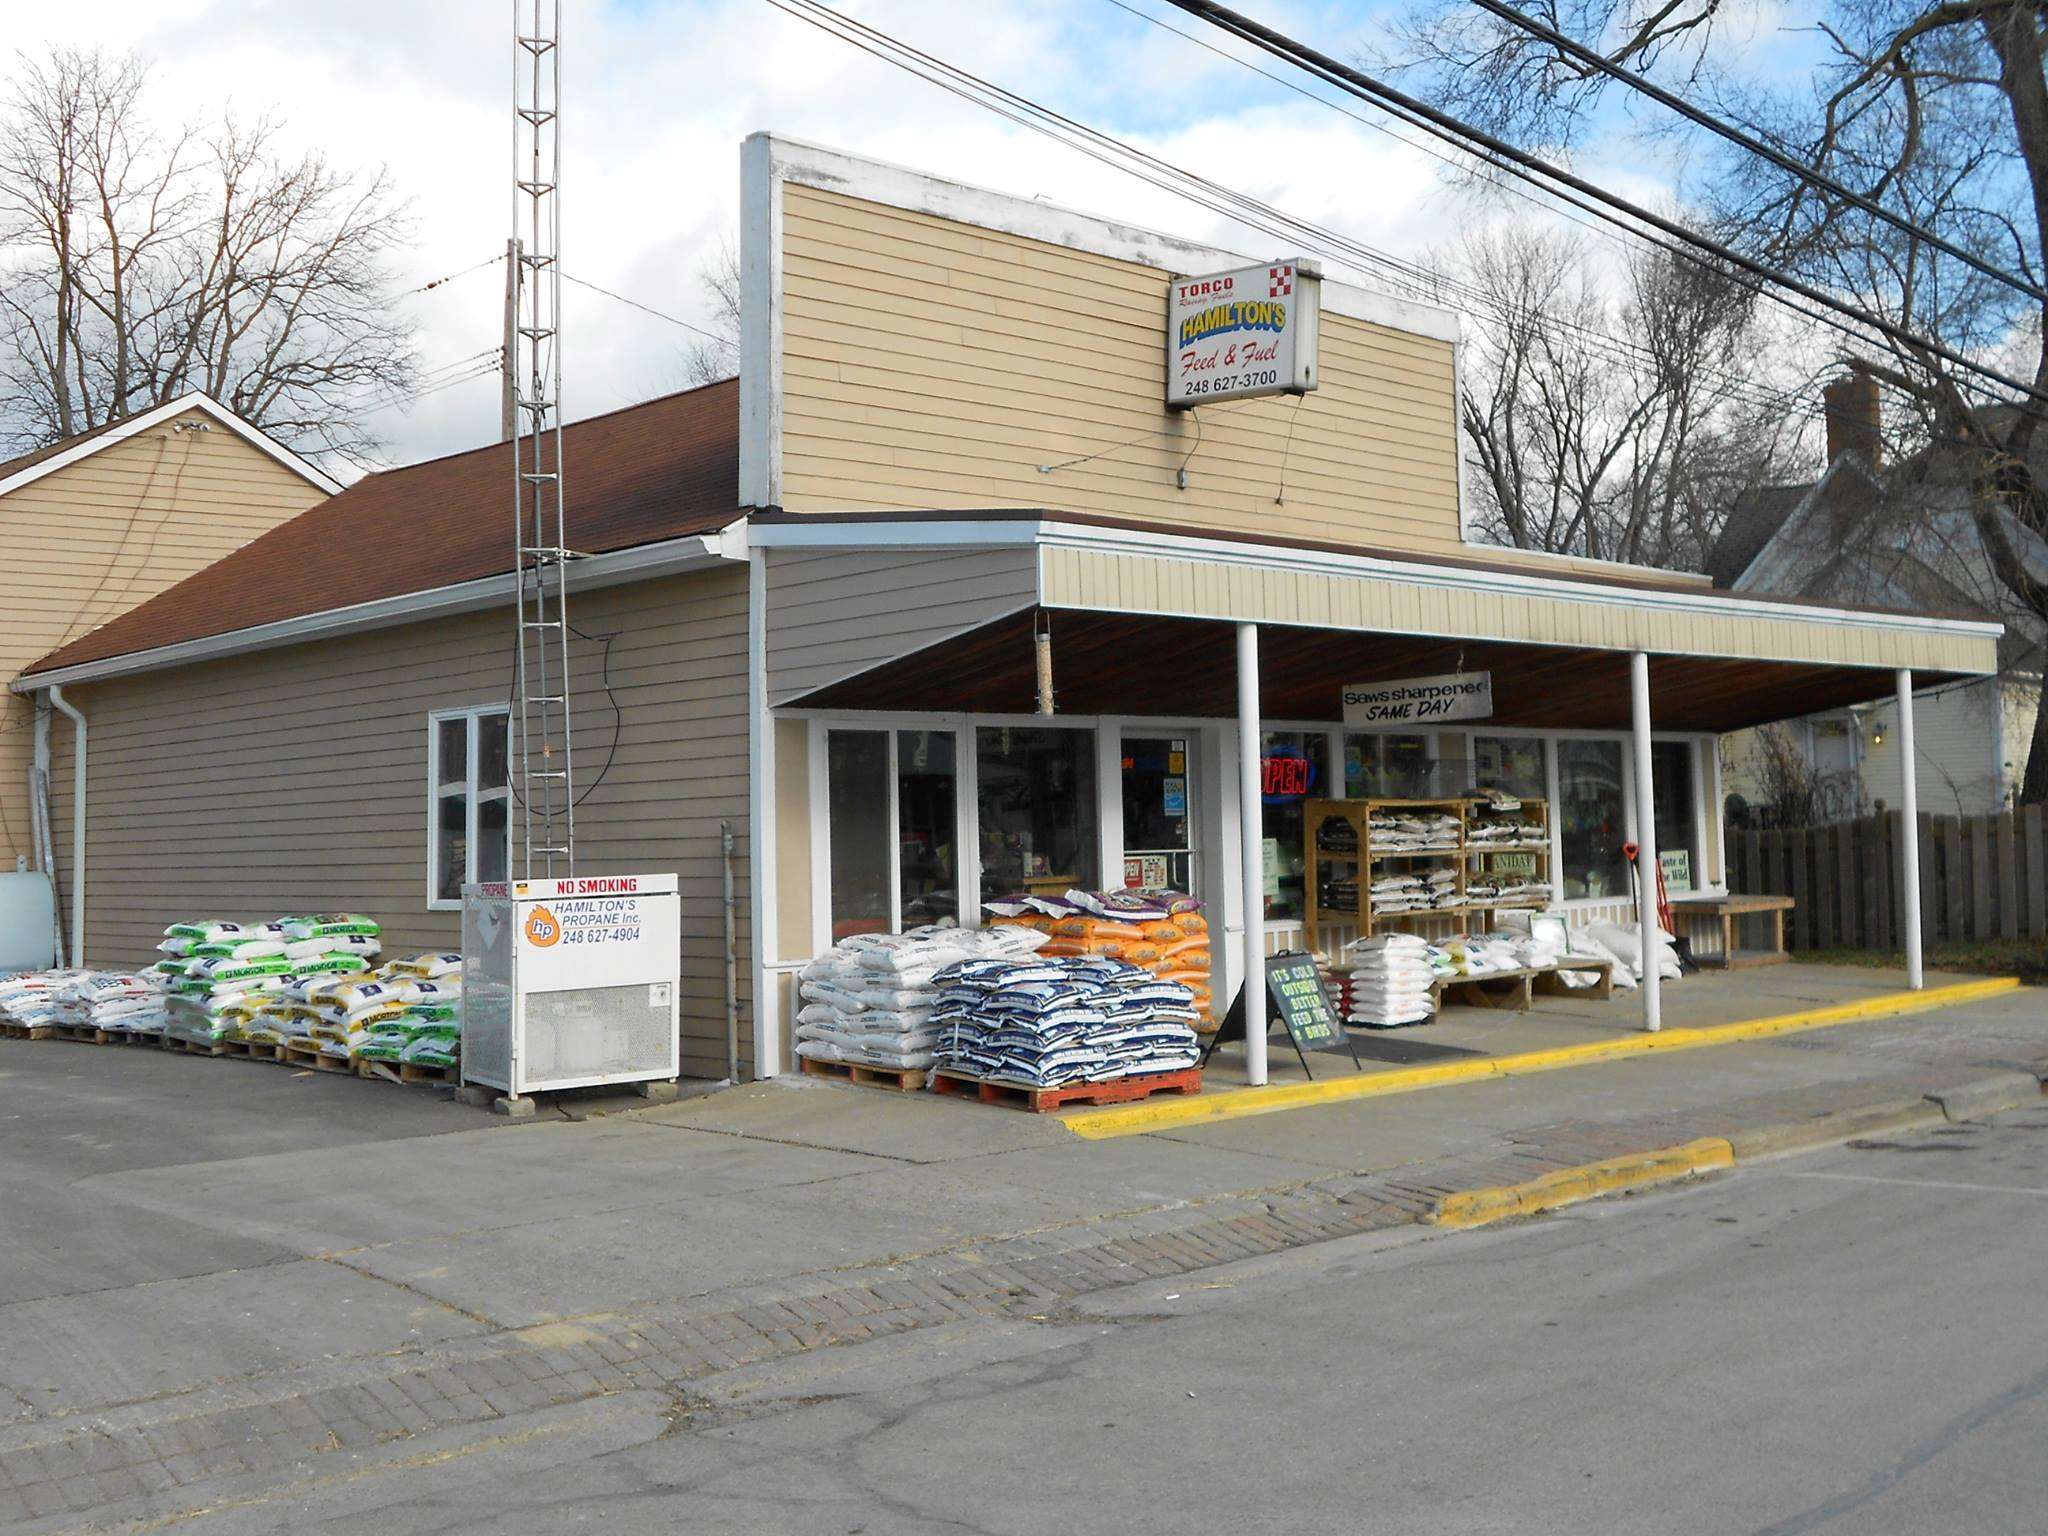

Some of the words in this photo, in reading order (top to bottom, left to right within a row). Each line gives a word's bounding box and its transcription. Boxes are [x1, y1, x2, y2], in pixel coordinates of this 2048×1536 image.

[1179, 277, 1234, 298] TORCO
[1180, 301, 1286, 346] HAMILTON'S
[1181, 349, 1219, 377] Feed
[1224, 343, 1237, 366] &
[1241, 339, 1280, 369] Fuel
[1185, 380, 1209, 396] 248
[1213, 369, 1277, 391] 627-3700
[1344, 690, 1390, 706] Saws
[1366, 702, 1413, 721] SAME
[1416, 698, 1455, 717] DAY
[1261, 757, 1308, 794] PEN
[557, 880, 574, 894] NO
[579, 878, 637, 893] SMOKING
[554, 900, 636, 914] HAMILTON'S
[562, 914, 619, 926] PROPANE
[622, 914, 641, 924] Inc.
[329, 925, 358, 934] MORTON
[533, 919, 553, 938] hp
[563, 929, 583, 944] 248
[587, 927, 640, 943] 627-4904
[233, 966, 266, 977] MORTON
[308, 961, 338, 973] MORTON
[1292, 965, 1315, 979] COLD
[1291, 1011, 1312, 1026] FEED
